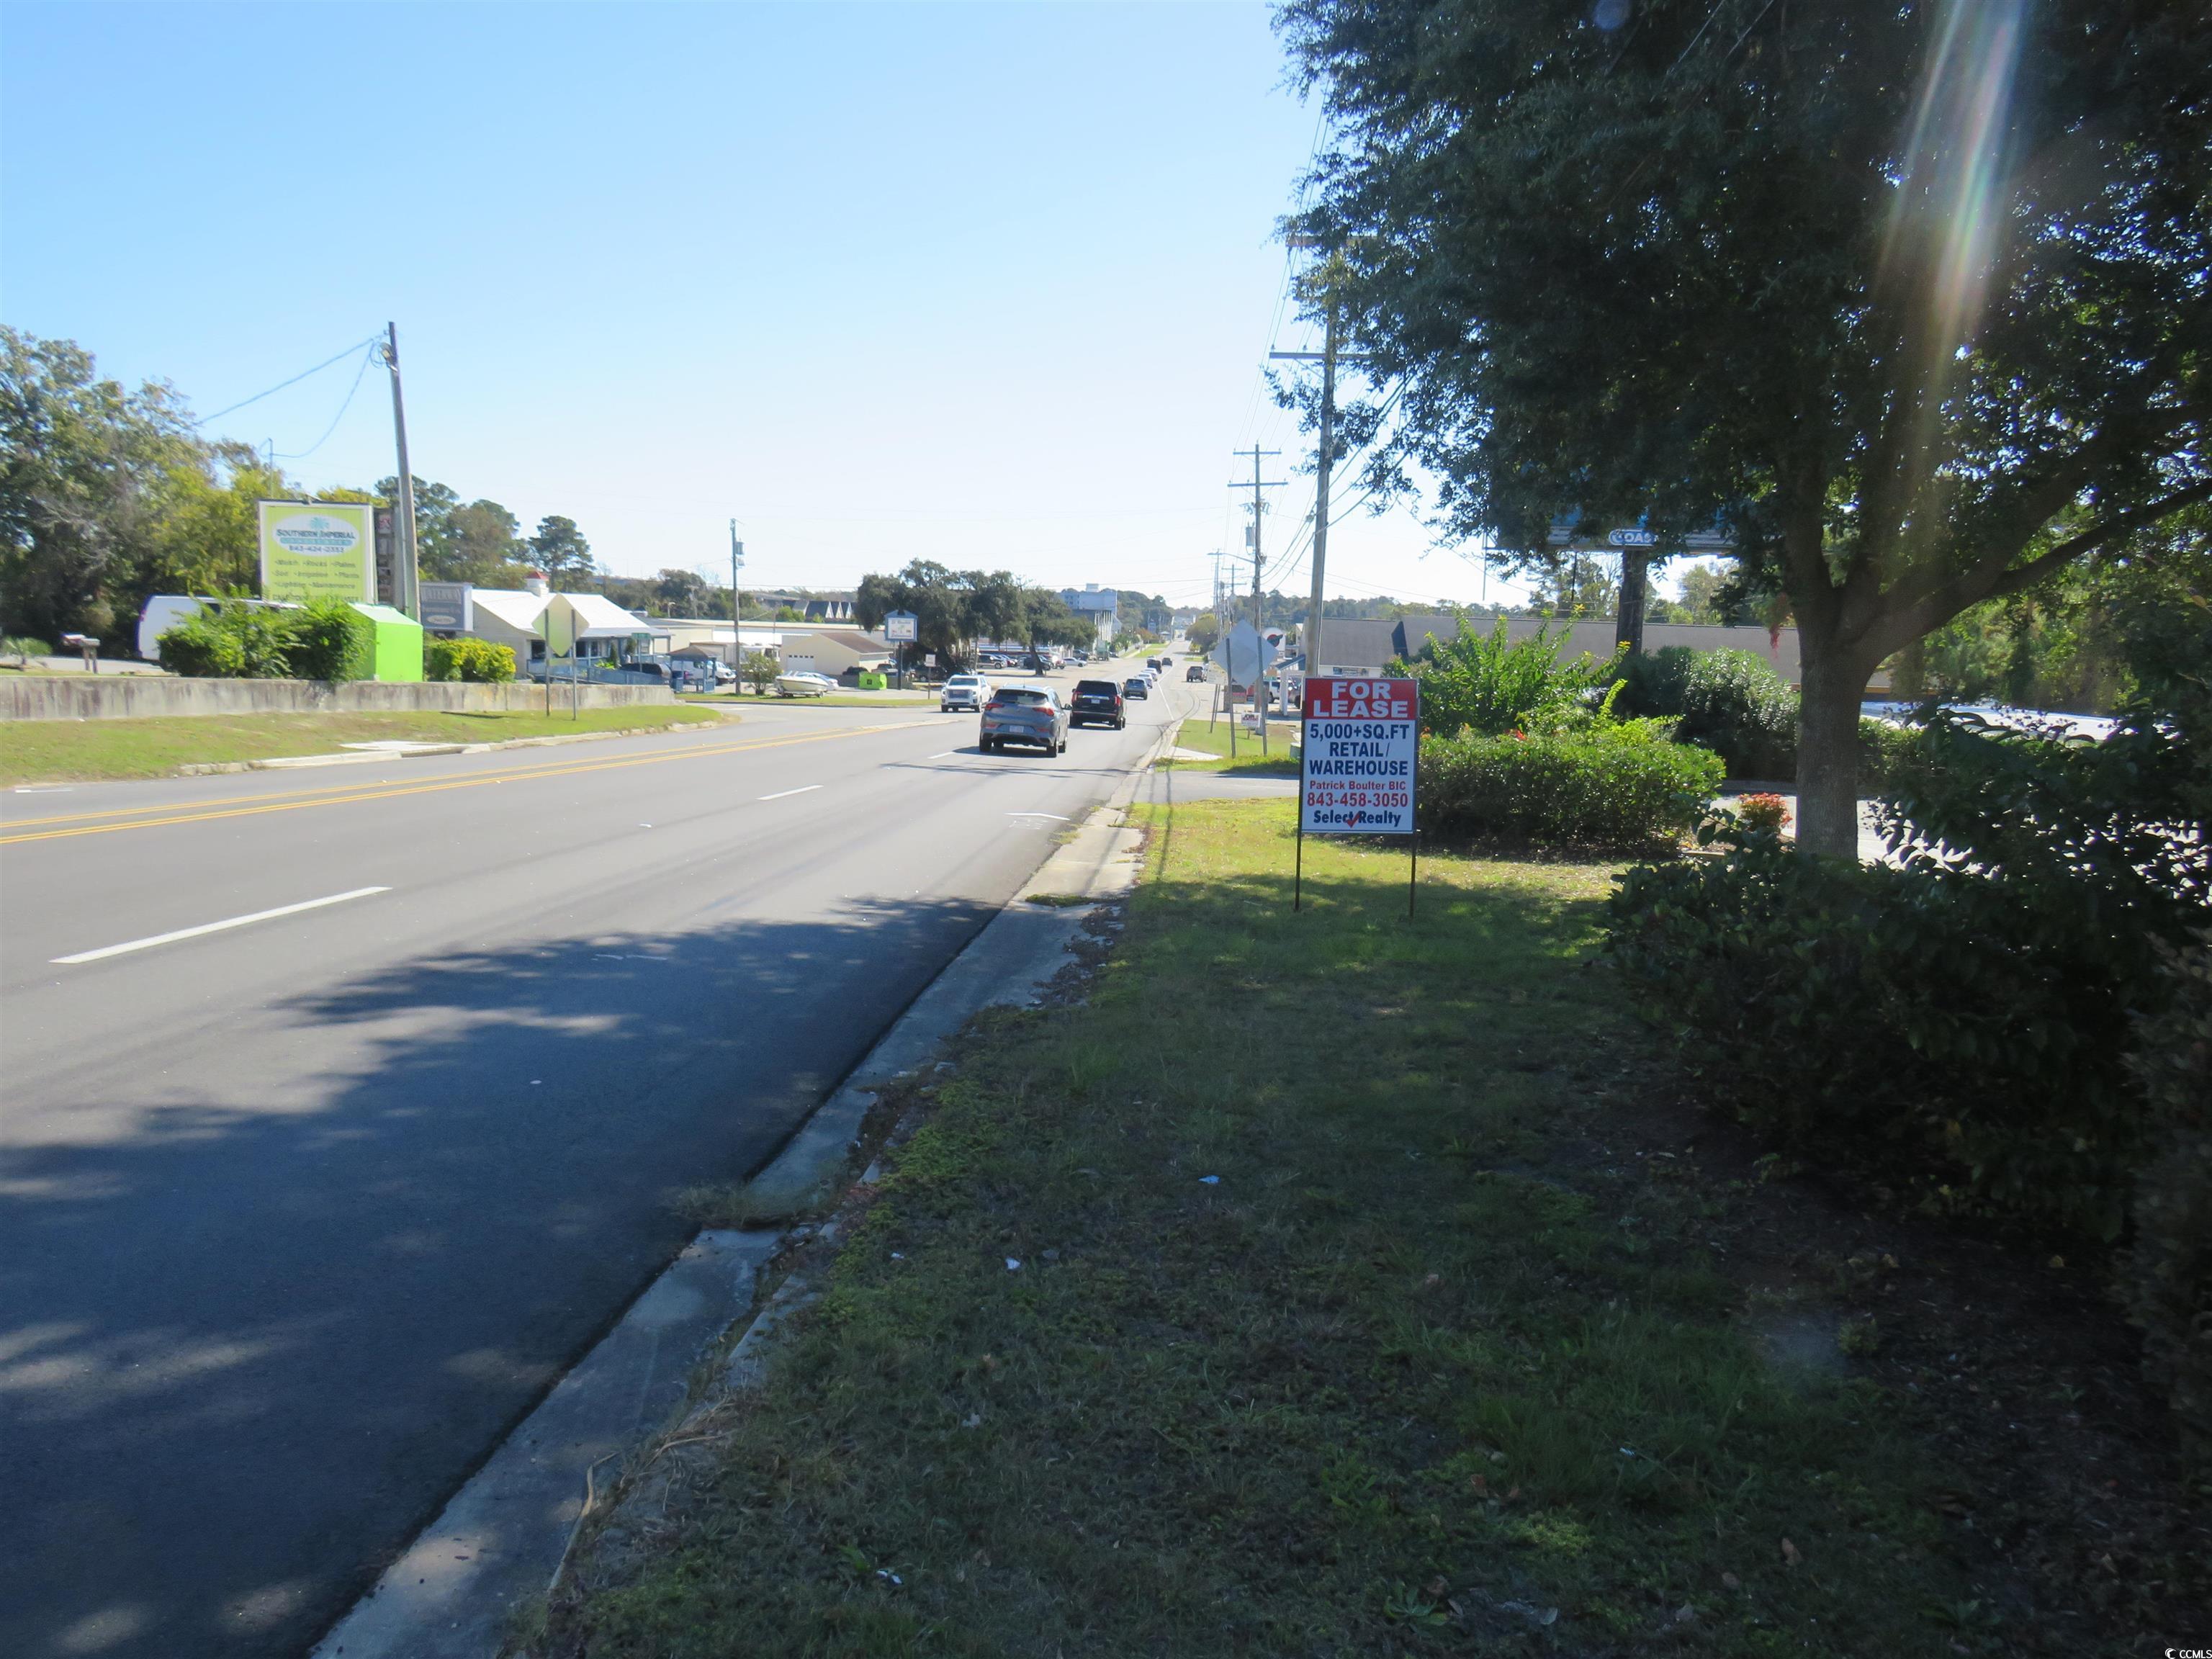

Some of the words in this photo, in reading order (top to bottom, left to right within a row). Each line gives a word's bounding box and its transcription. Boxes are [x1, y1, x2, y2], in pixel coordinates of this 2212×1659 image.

[320, 530, 356, 539] IMPERIAL
[1331, 681, 1392, 700] FOR
[1313, 700, 1408, 718] LEASE
[1310, 723, 1409, 740] 5,000+SQ.FT
[1309, 760, 1408, 775] WAREHOUSE
[1310, 781, 1345, 790] Patrick
[1349, 781, 1385, 790] Boulter
[1389, 781, 1406, 790] BIC
[1307, 792, 1408, 807] 843-458-3050
[1313, 810, 1354, 824] Select
[1358, 810, 1401, 827] Realty
